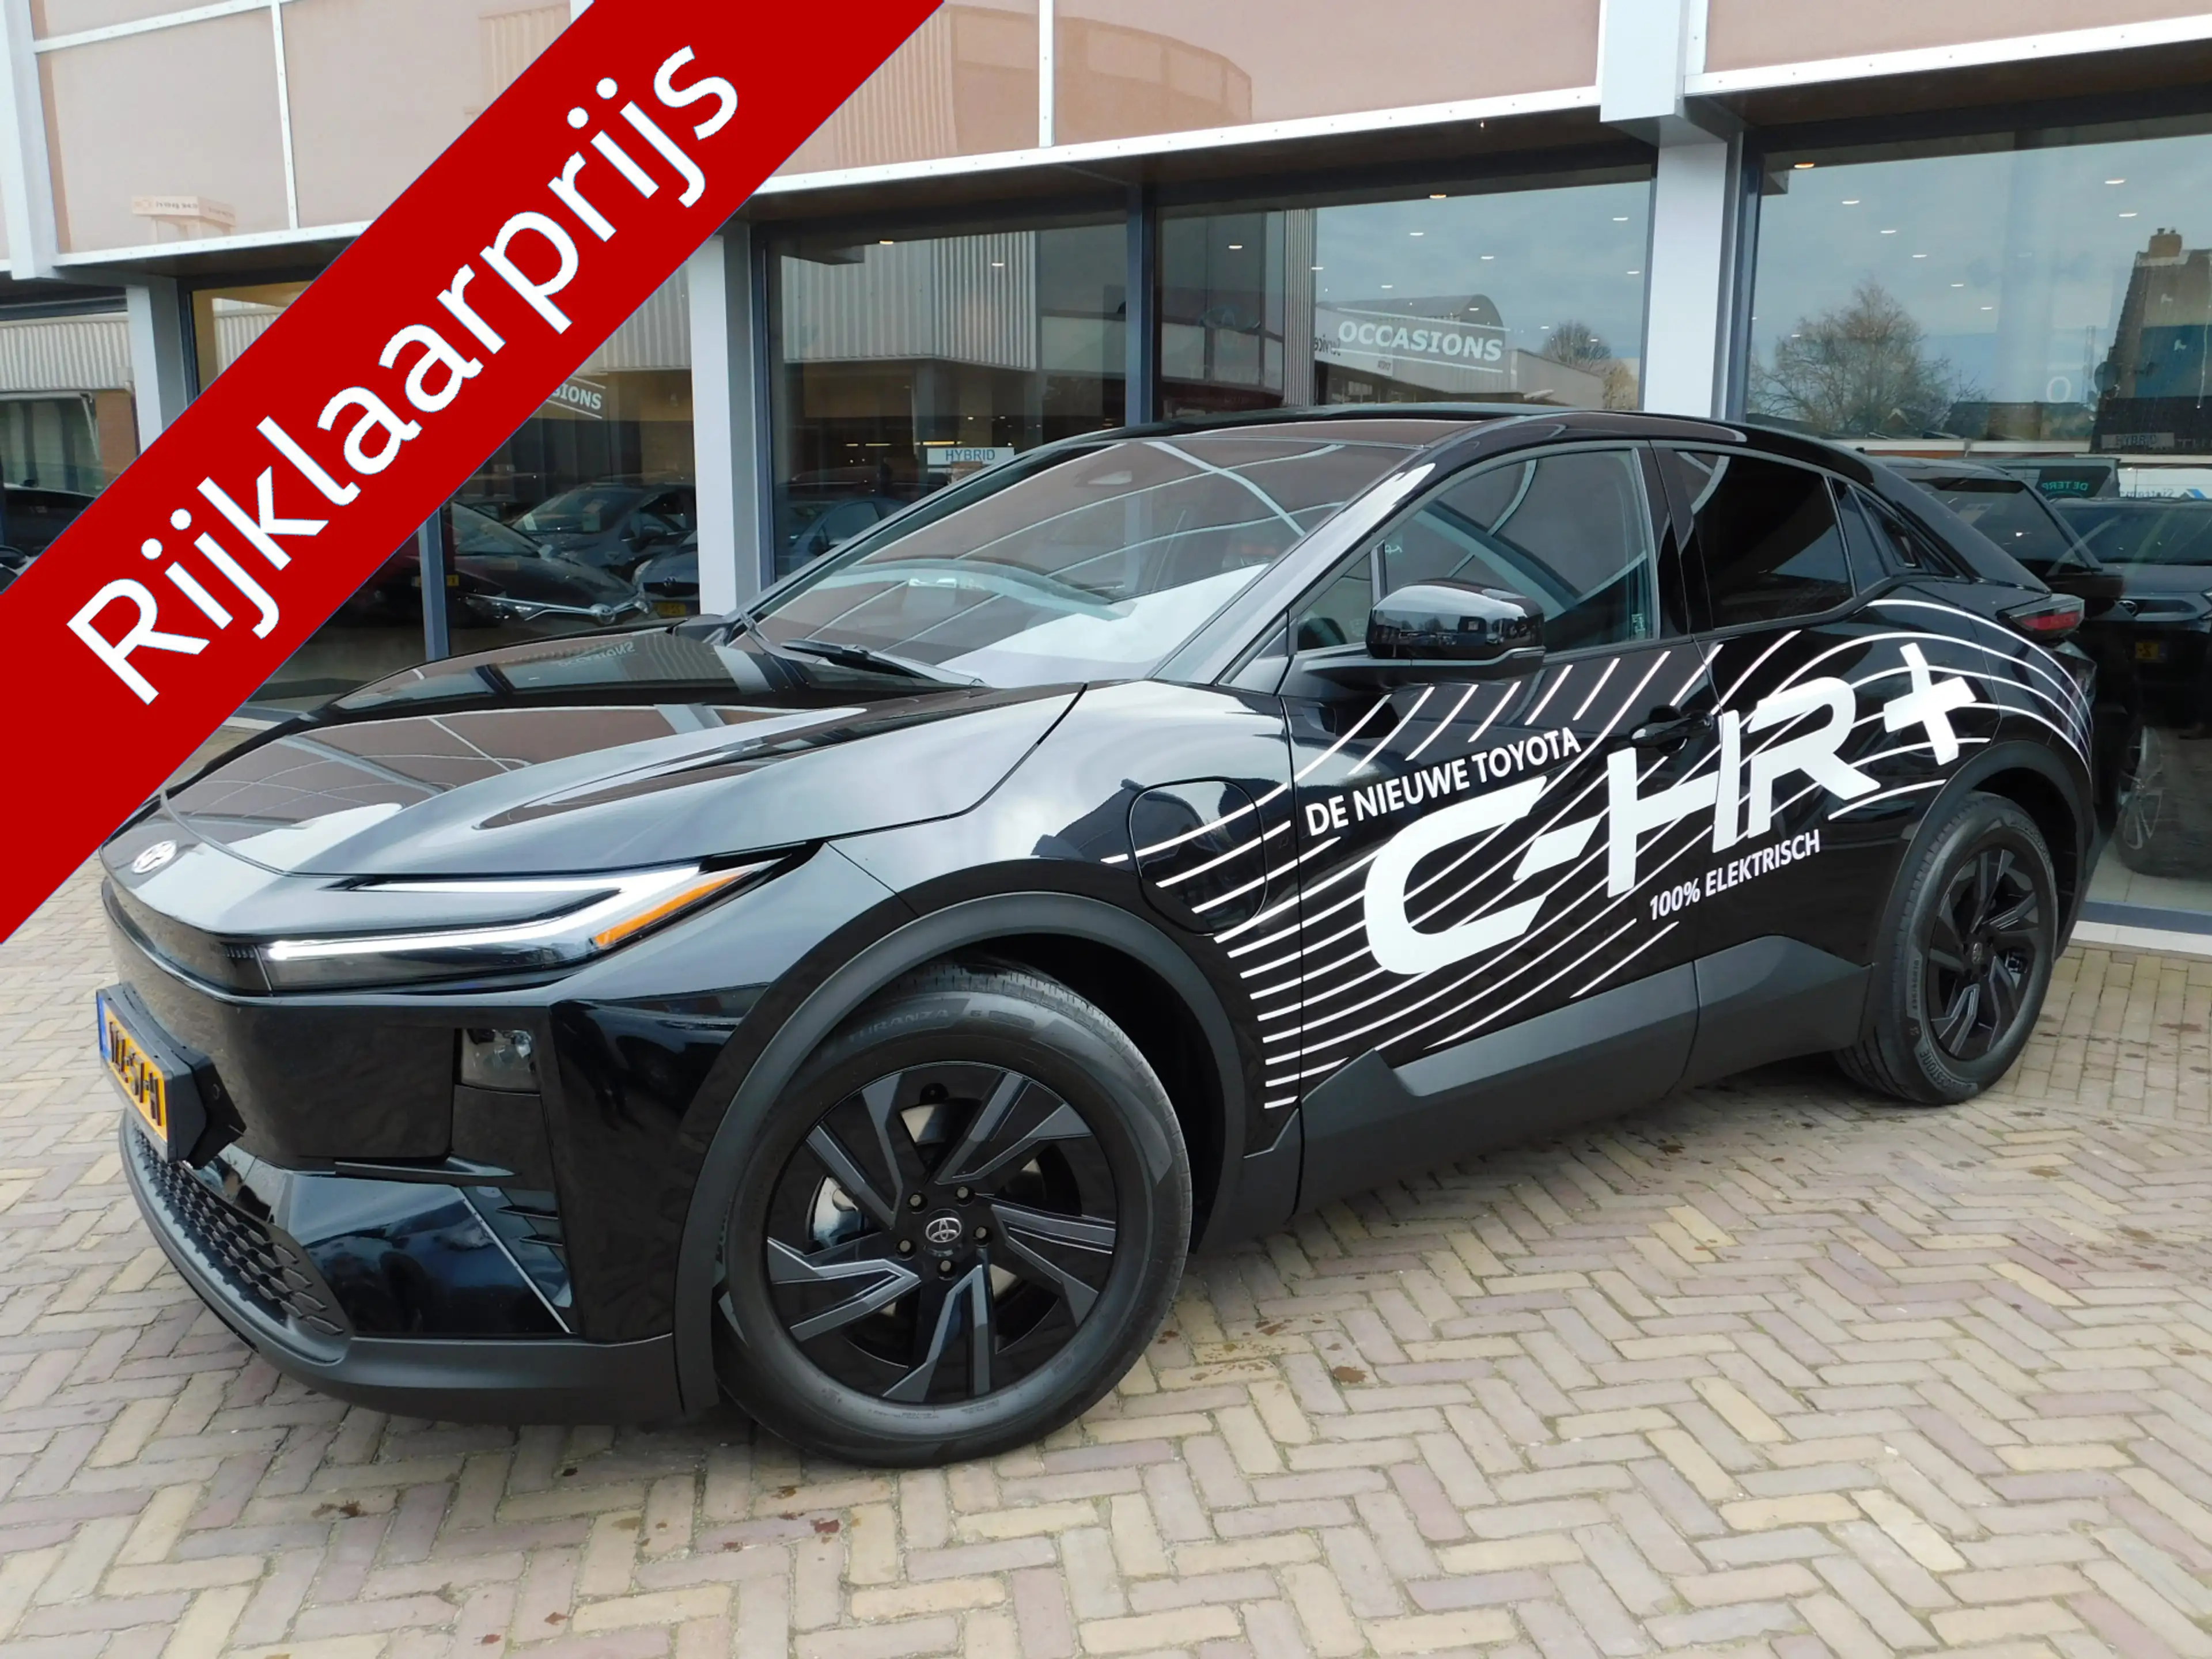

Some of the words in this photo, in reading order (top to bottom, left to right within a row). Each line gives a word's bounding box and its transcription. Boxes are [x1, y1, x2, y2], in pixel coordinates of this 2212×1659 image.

[1338, 320, 1503, 362] OCCASIONS
[944, 448, 996, 463] HYBRID
[1305, 795, 1349, 836] DE
[1353, 758, 1471, 821] NIEUWE
[1471, 726, 1582, 783] TOYOTA
[1649, 877, 1701, 921] 100%
[1705, 828, 1821, 897] ELEKTRISCH
